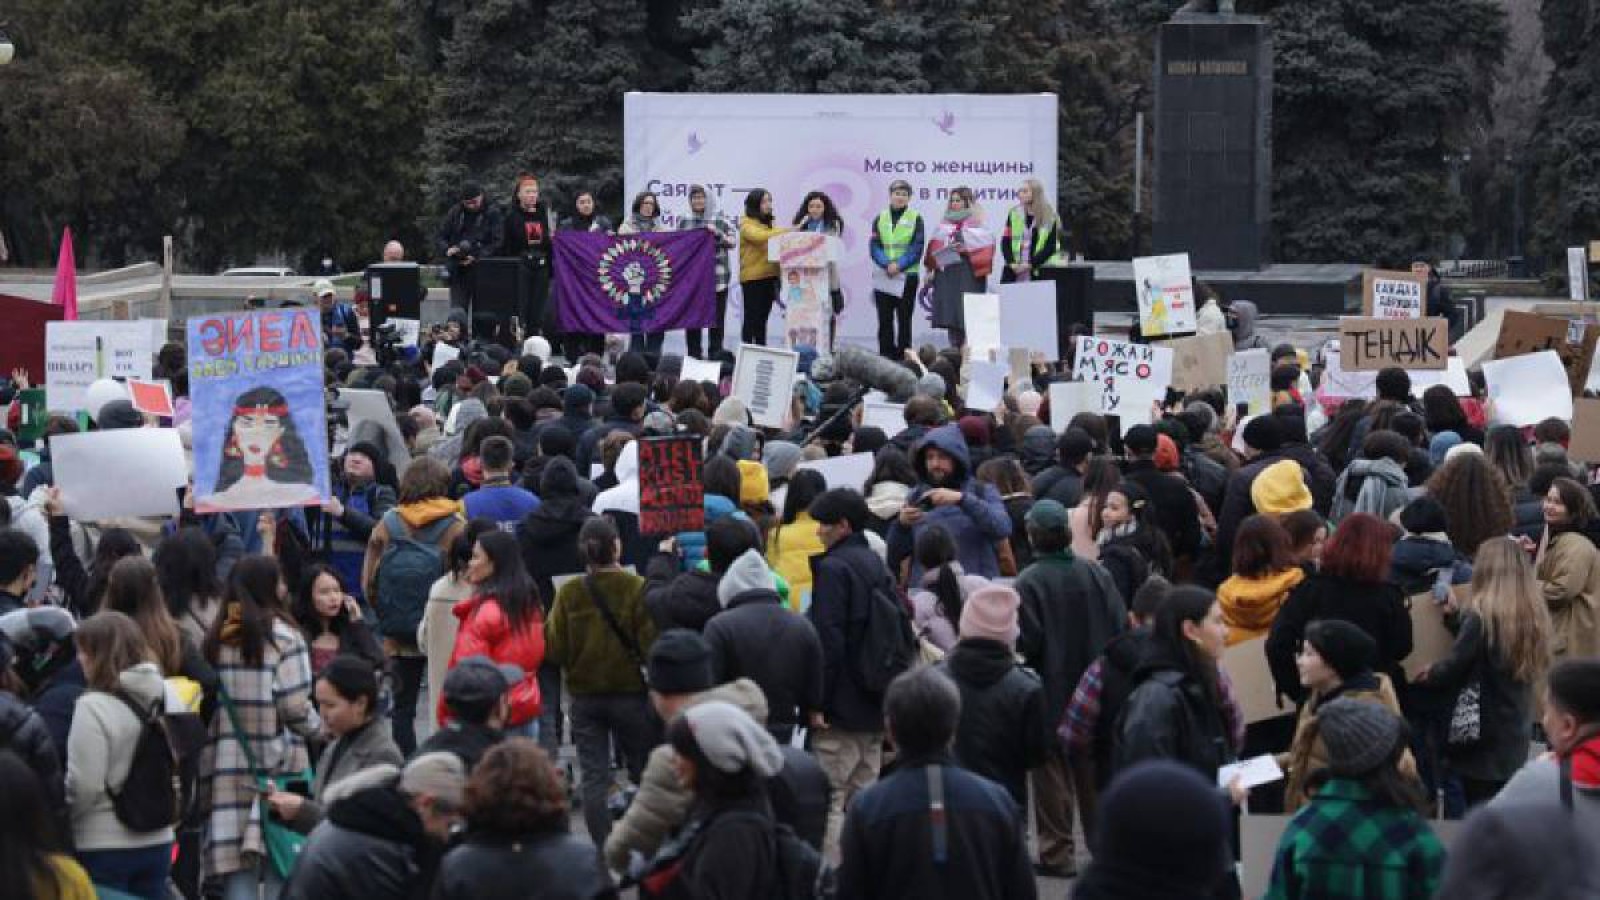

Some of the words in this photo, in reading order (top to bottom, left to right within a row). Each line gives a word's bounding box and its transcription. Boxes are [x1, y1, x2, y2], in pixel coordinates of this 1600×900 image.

[863, 158, 927, 173] Место
[932, 159, 1033, 175] женщины
[647, 179, 726, 197] Саят
[919, 187, 930, 200] в
[936, 187, 1019, 201] питик
